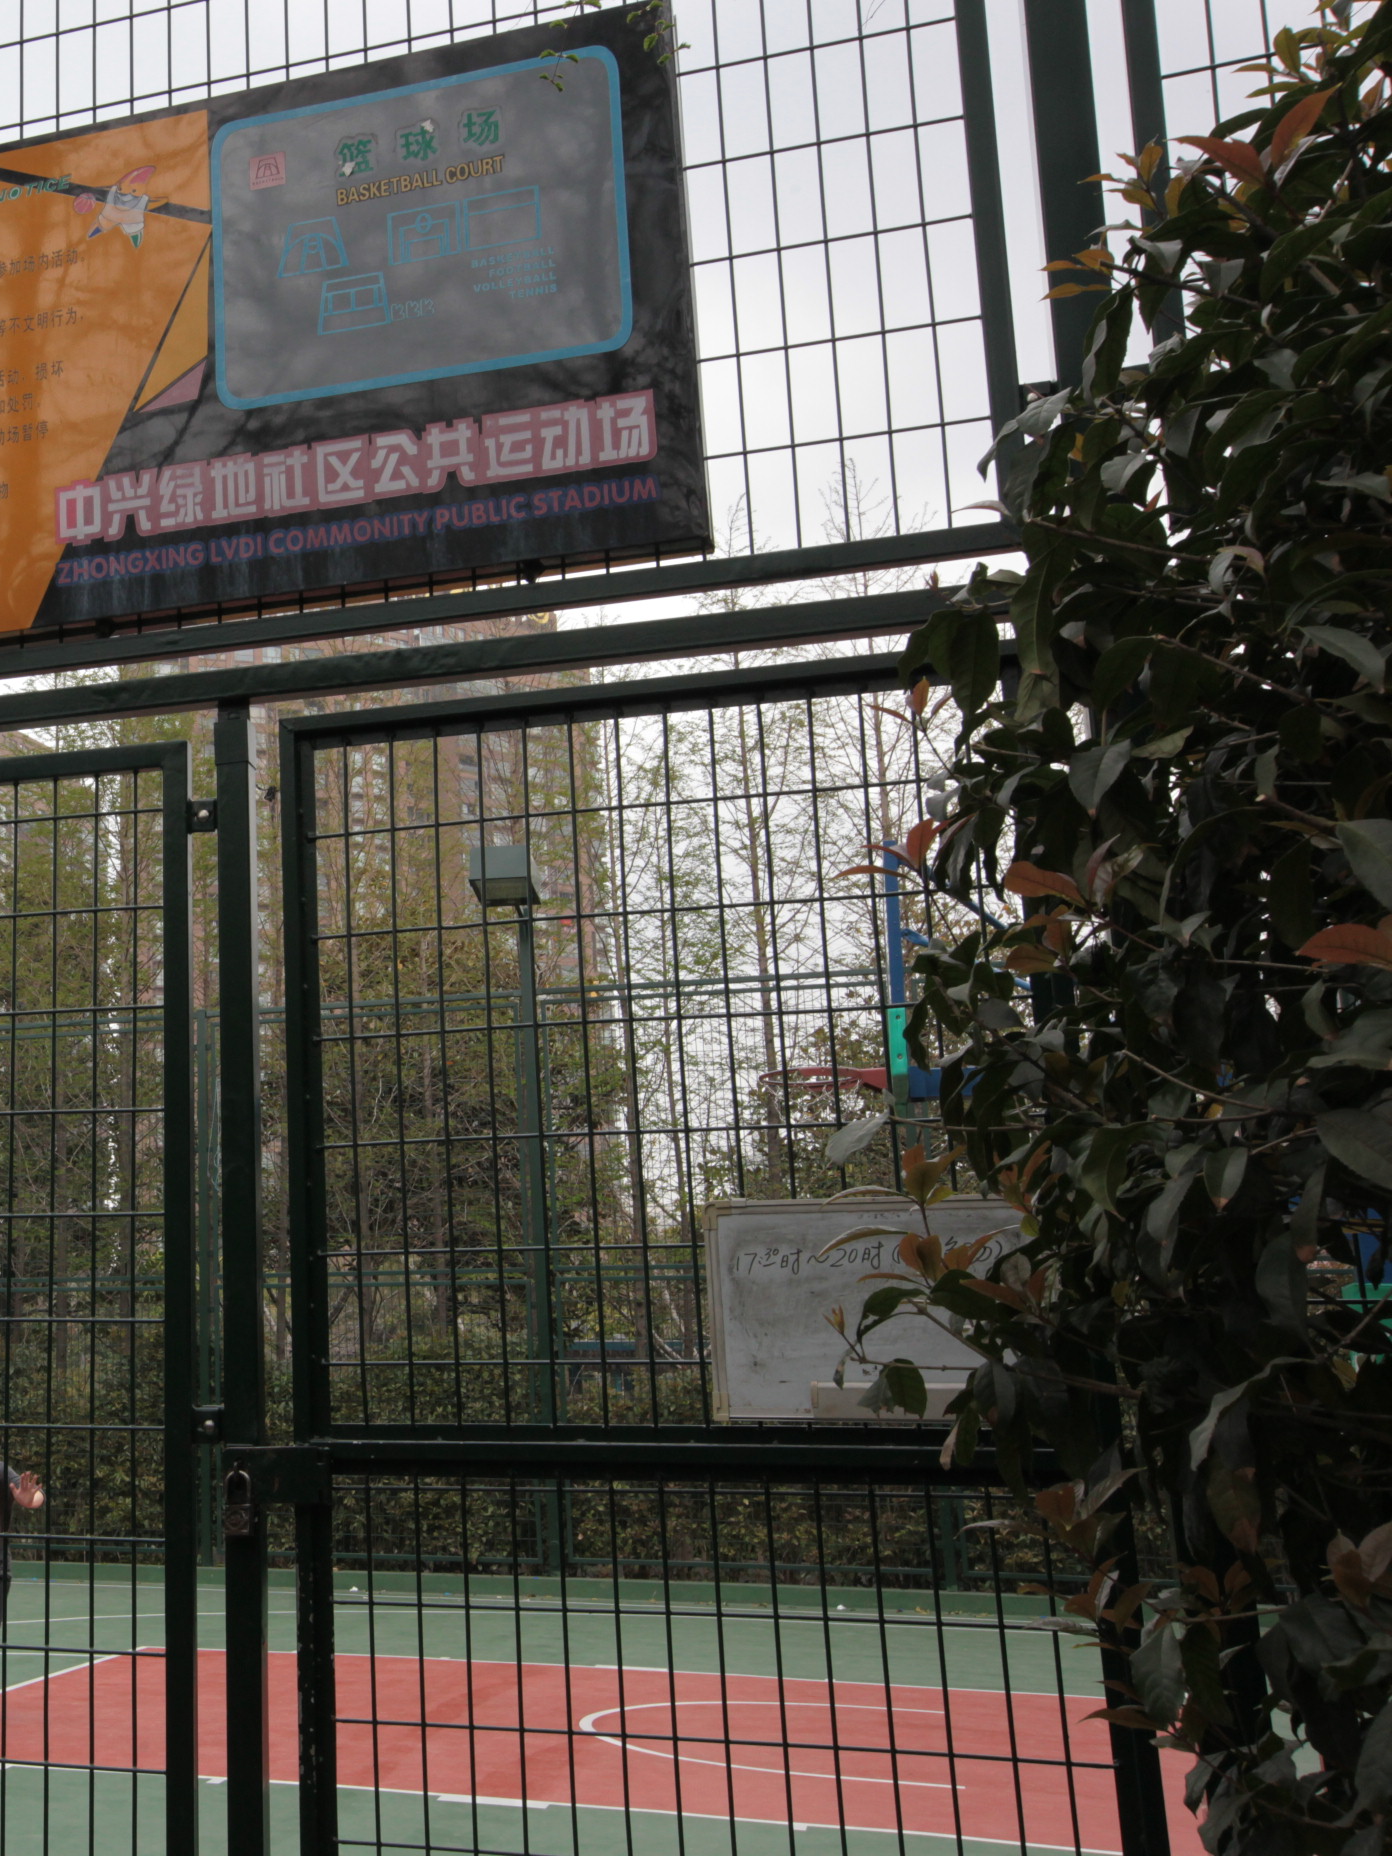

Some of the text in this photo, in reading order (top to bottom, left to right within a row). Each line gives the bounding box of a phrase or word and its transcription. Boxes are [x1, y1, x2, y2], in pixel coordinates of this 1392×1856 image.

[337, 108, 501, 178] 篮球场
[336, 154, 505, 206] BASKETBALL COURT
[470, 247, 555, 268] BASKETBALL
[488, 259, 556, 278] FOOTBALL
[473, 271, 557, 293] VOLLEYBALL
[509, 283, 558, 299] TENNIS
[57, 392, 654, 543] 中兴绿地社区公共运动场
[56, 476, 658, 587] ZHONGXING LVDI COMMONITY PUBLIC STADIUM
